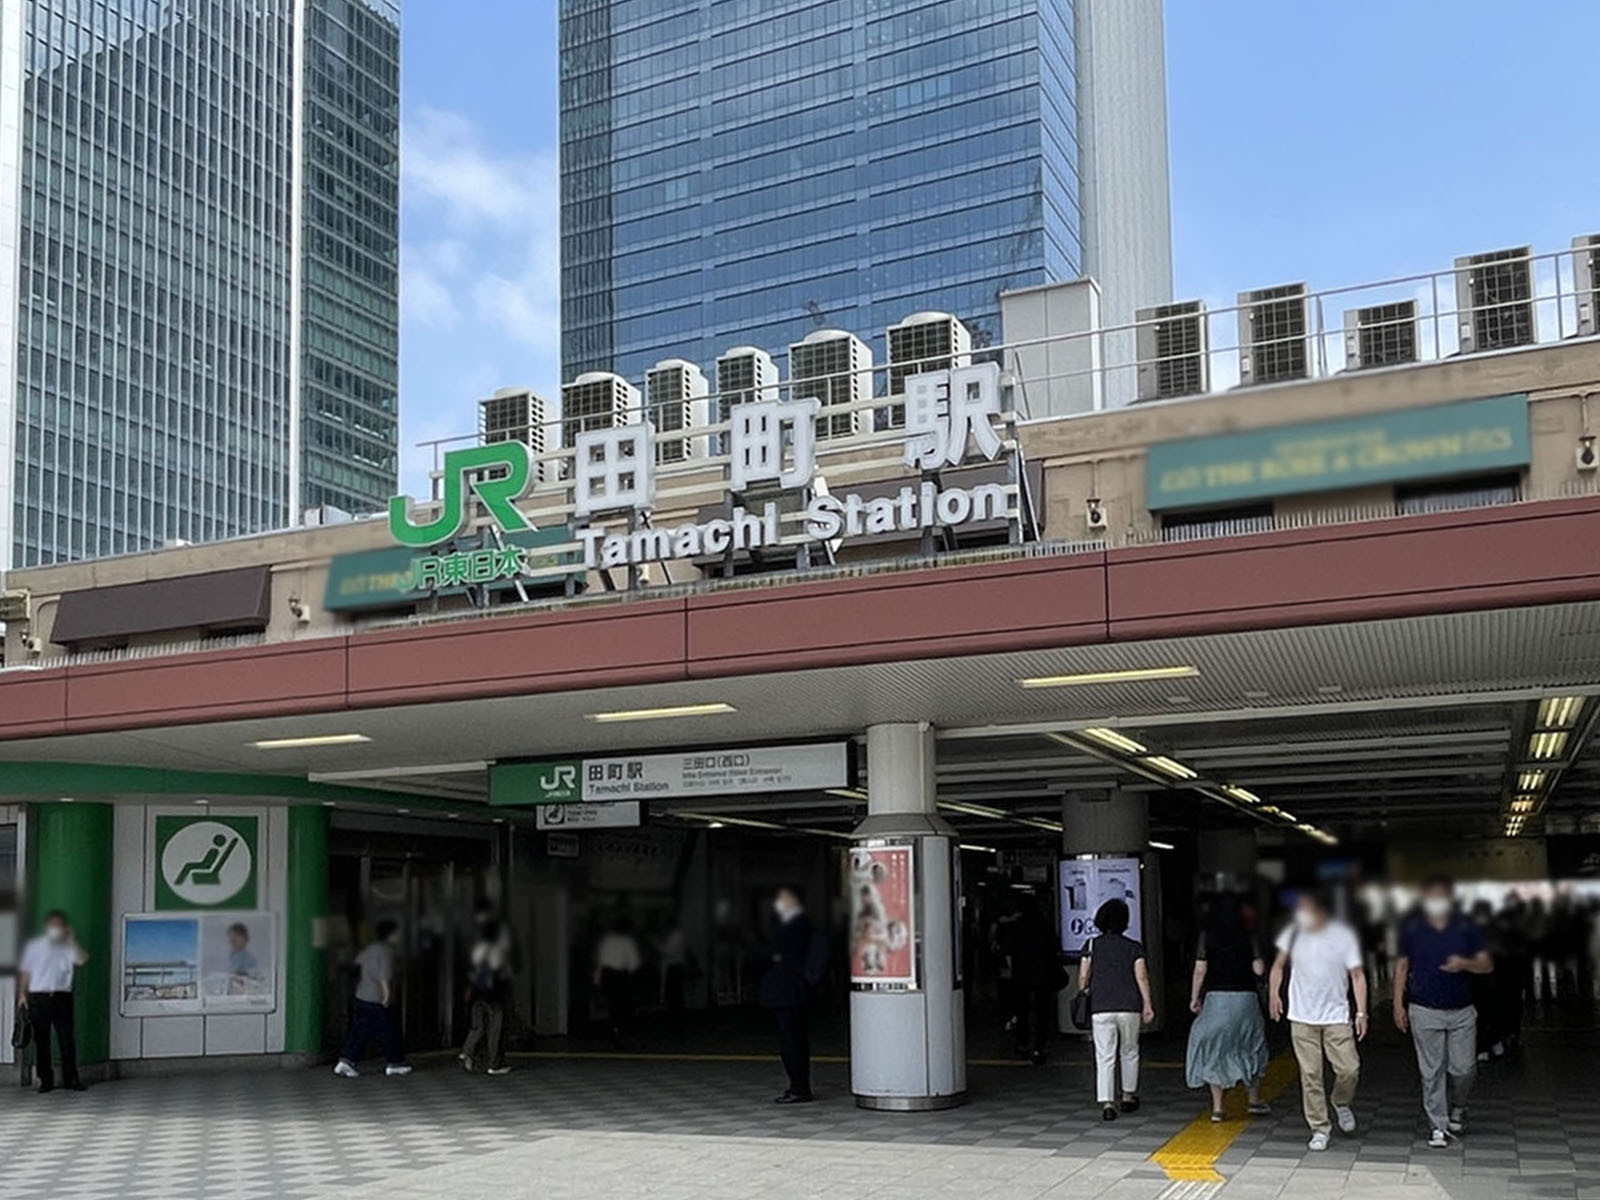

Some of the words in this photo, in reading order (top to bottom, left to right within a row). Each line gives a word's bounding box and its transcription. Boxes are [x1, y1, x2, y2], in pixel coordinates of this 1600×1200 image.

[575, 361, 1002, 517] 田町駅
[388, 439, 539, 547] JR
[575, 501, 780, 569] Tamachi
[807, 481, 1006, 541] Station
[397, 544, 526, 593] JR東日本
[540, 765, 576, 790] JR
[588, 761, 643, 781] 田町駅
[589, 782, 631, 794] Tamachi
[633, 781, 670, 792] Station
